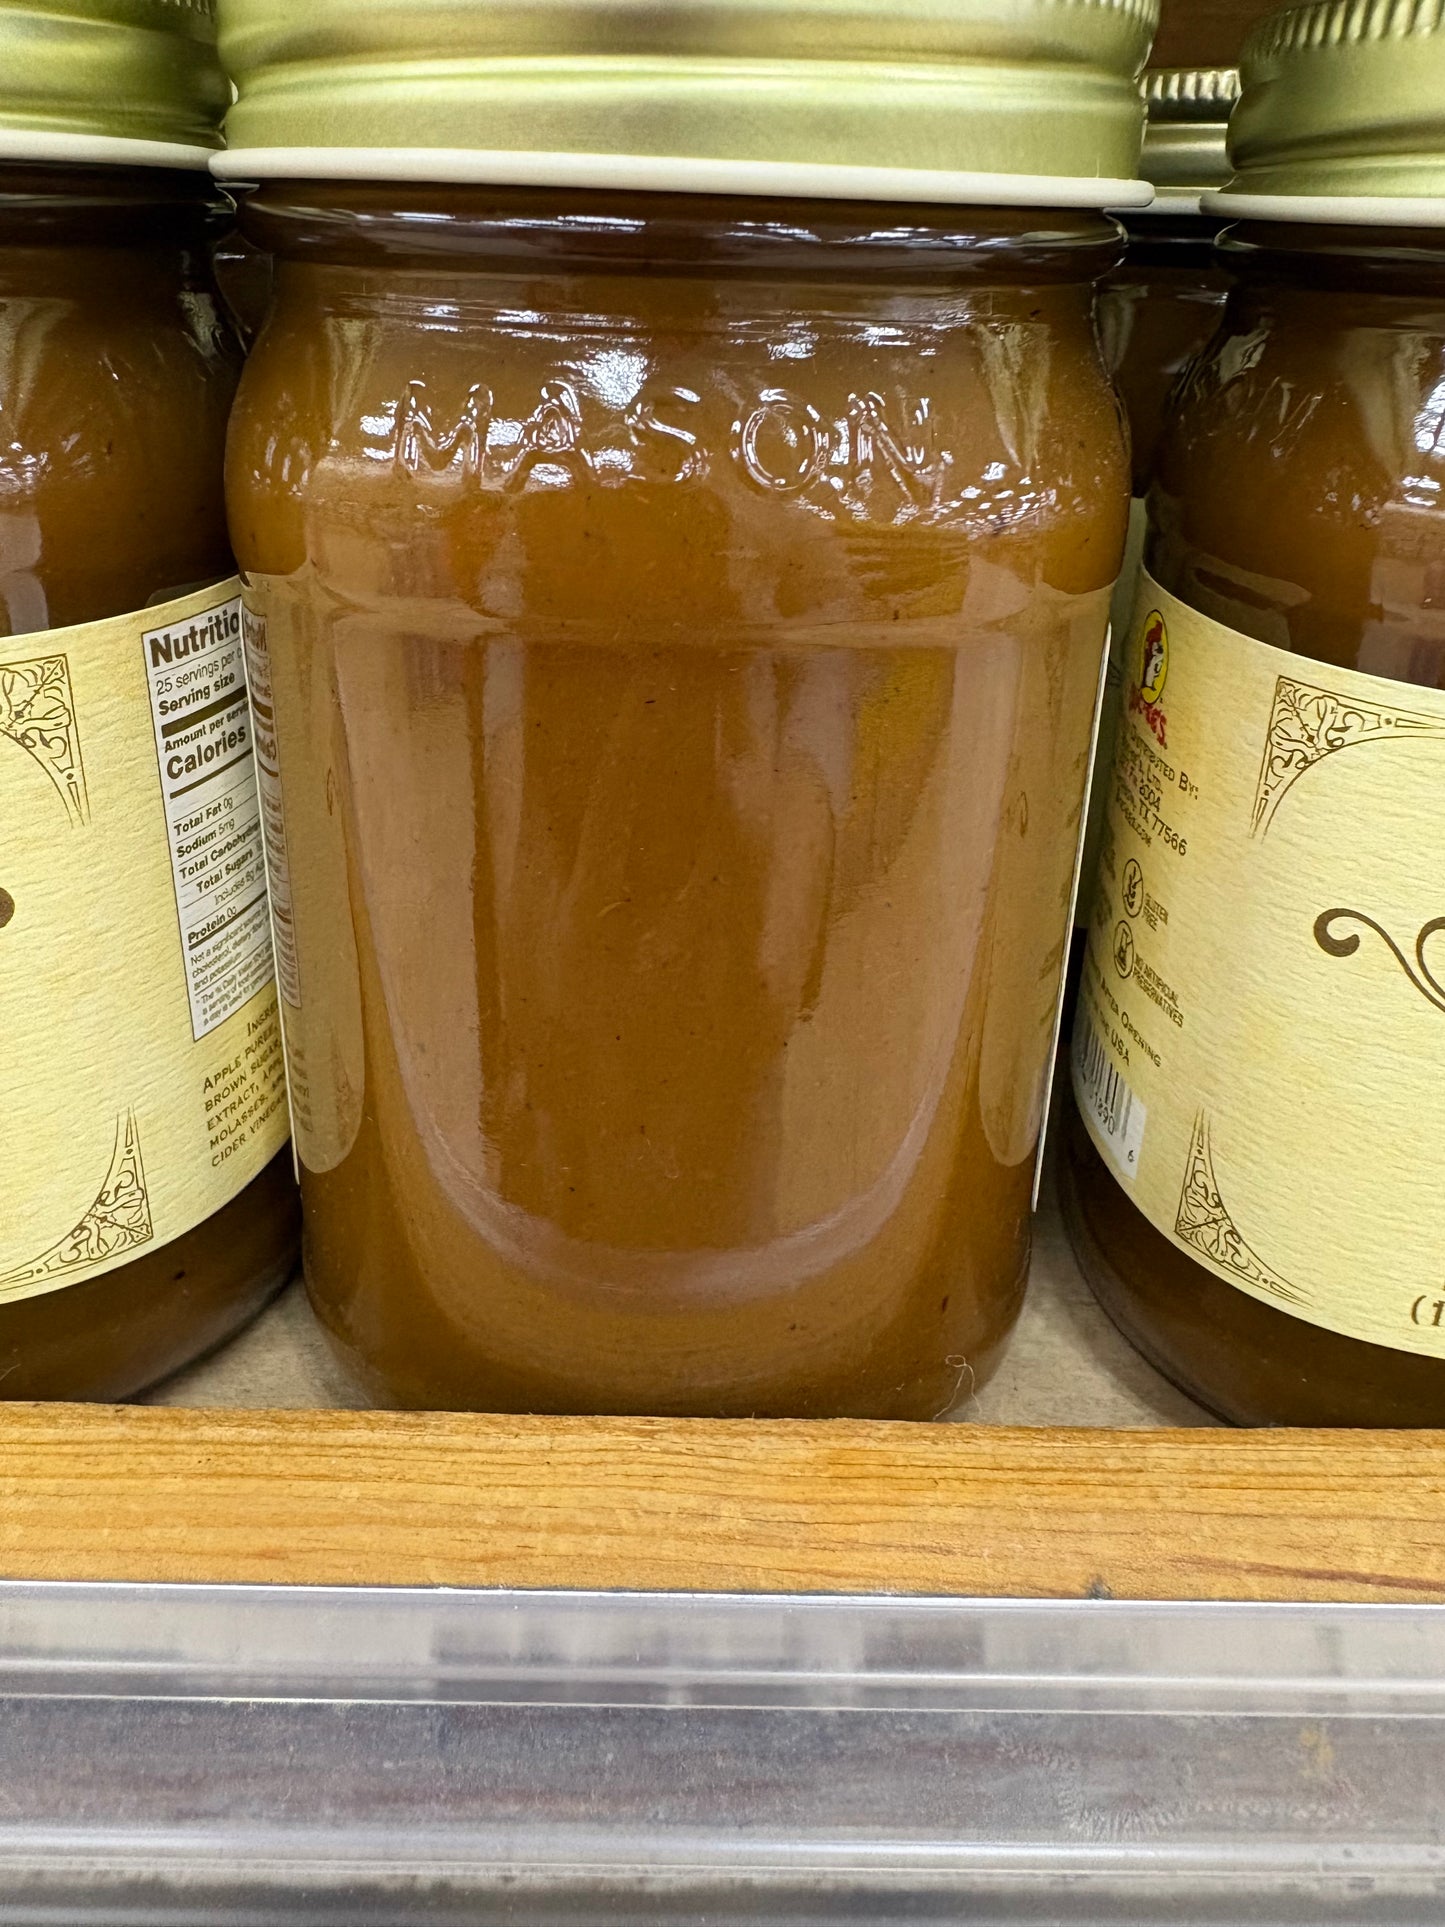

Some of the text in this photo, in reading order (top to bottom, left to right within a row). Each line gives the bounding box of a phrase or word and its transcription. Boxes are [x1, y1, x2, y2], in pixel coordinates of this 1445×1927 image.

[150, 608, 240, 668] Nutritio
[156, 678, 172, 696] 25
[175, 656, 219, 687] servings
[158, 683, 211, 716] Serving
[213, 672, 235, 692] size
[164, 726, 207, 753] Amount
[209, 717, 225, 735] per
[166, 726, 247, 780] Calories
[174, 812, 203, 836] Total
[206, 802, 222, 820] Fat
[176, 818, 235, 858] Sodium 5mg
[1152, 813, 1187, 856] 77566
[179, 855, 209, 879] Total
[196, 869, 223, 893] Total
[188, 912, 225, 944] Protein
[1111, 1033, 1129, 1066] USA
[203, 1054, 242, 1094] APPLE
[204, 1070, 247, 1112] BROWN
[207, 1082, 259, 1131] EXTRACT,
[212, 1132, 246, 1167] CIDER
